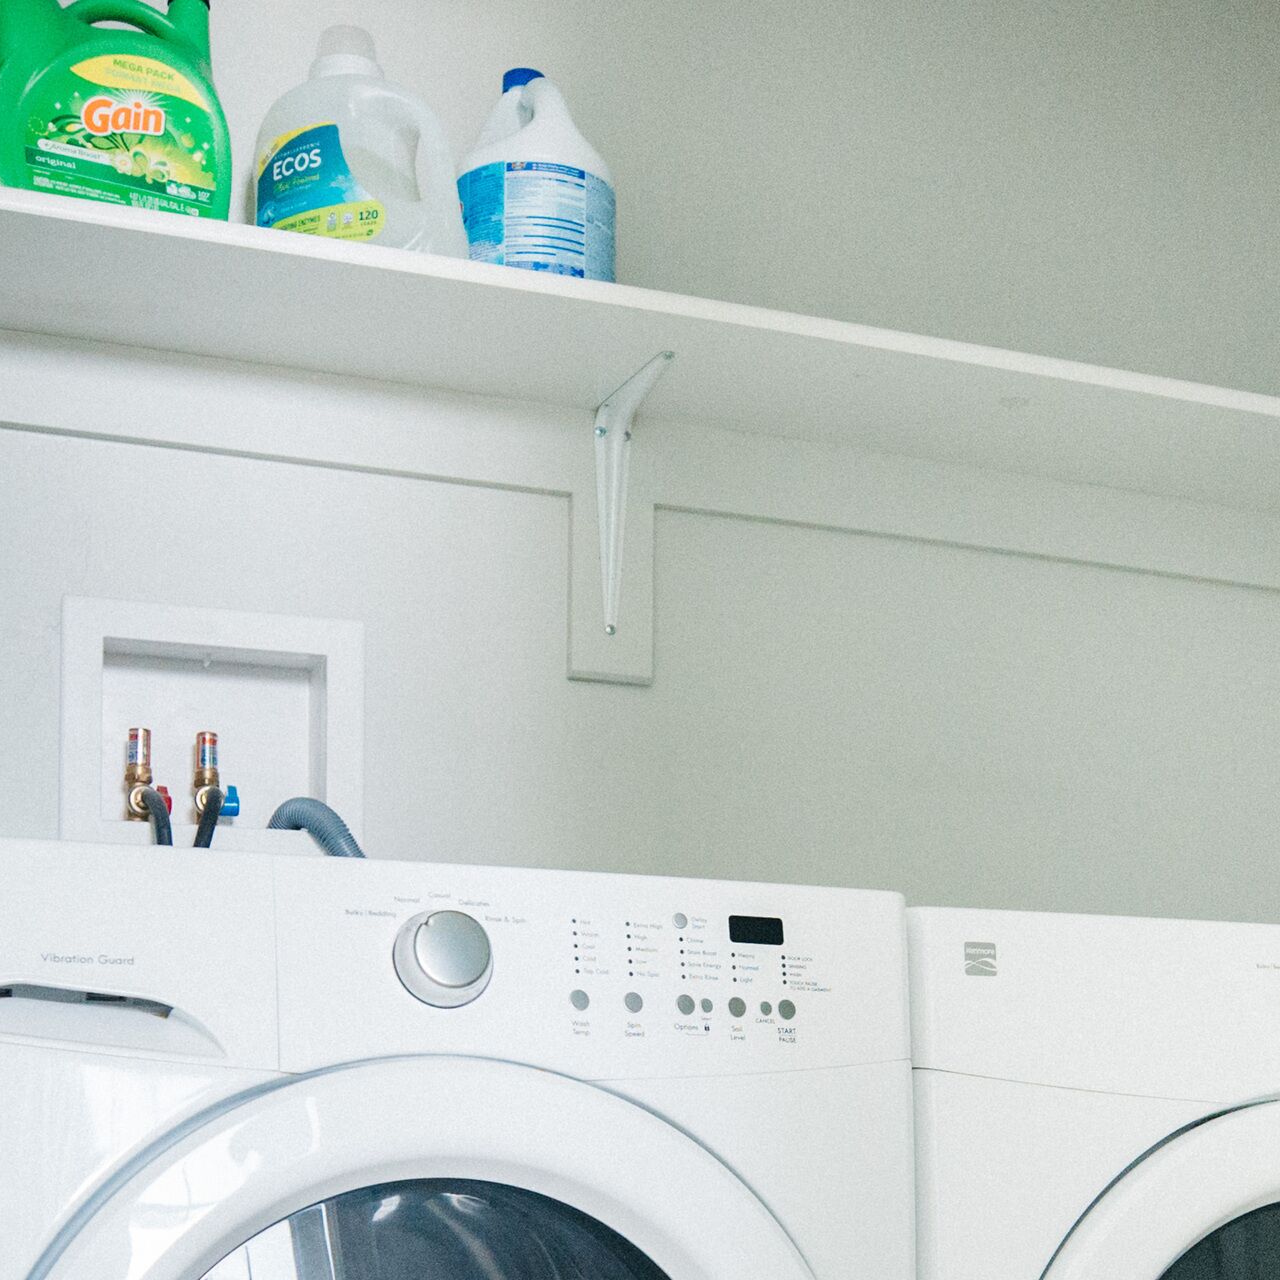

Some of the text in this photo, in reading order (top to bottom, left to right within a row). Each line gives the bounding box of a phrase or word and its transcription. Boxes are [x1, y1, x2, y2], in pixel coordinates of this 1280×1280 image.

[112, 59, 174, 80] MEGA PACK
[83, 98, 164, 134] Gain
[35, 155, 77, 169] original
[272, 148, 322, 181] ECOS
[359, 209, 379, 221] 120
[40, 952, 135, 966] Vibration Guard
[777, 1026, 797, 1035] START
